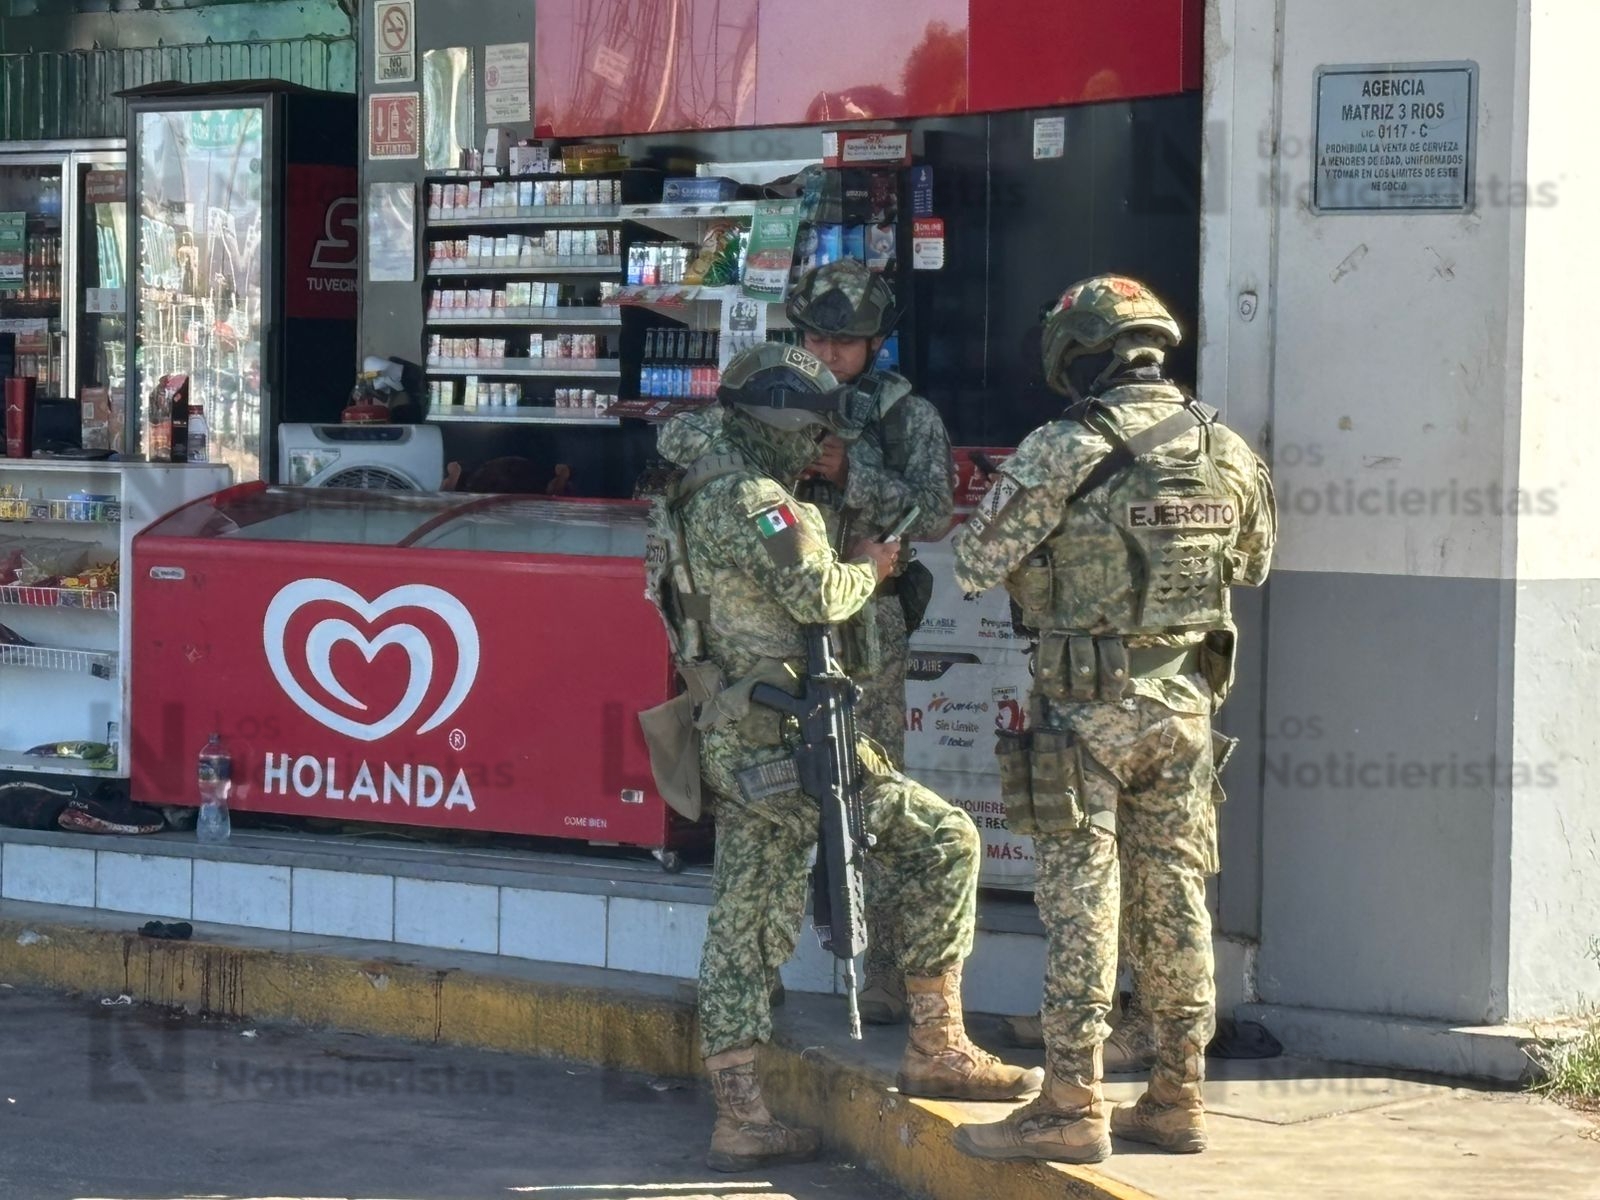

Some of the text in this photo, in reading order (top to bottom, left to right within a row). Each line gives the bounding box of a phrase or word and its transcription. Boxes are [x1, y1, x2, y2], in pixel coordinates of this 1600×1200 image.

[389, 56, 402, 68] NO
[1361, 79, 1425, 97] AGENCIA
[1342, 102, 1445, 121] MATRIZ 3 RIOS
[1378, 124, 1408, 139] 0117
[1419, 123, 1428, 138] C
[375, 144, 411, 154] EXTINTOR
[1325, 140, 1459, 154] PROHIBIDA LA VENTA DE CERVEZA
[1320, 156, 1327, 166] A
[1328, 155, 1366, 166] MENORES
[1367, 155, 1378, 166] DE
[1405, 154, 1463, 165] UNIFORMADOS
[1325, 169, 1331, 179] Y
[1332, 168, 1360, 180] TOMAR
[1361, 168, 1372, 179] EN
[1374, 168, 1389, 178] LOS
[1424, 167, 1436, 177] DE
[1437, 166, 1458, 177] ESTE
[1371, 181, 1407, 191] NEGOCIO
[306, 277, 323, 291] TU
[921, 660, 943, 673] AIRE
[263, 751, 477, 813] HOLANDA
[564, 816, 587, 827] COME
